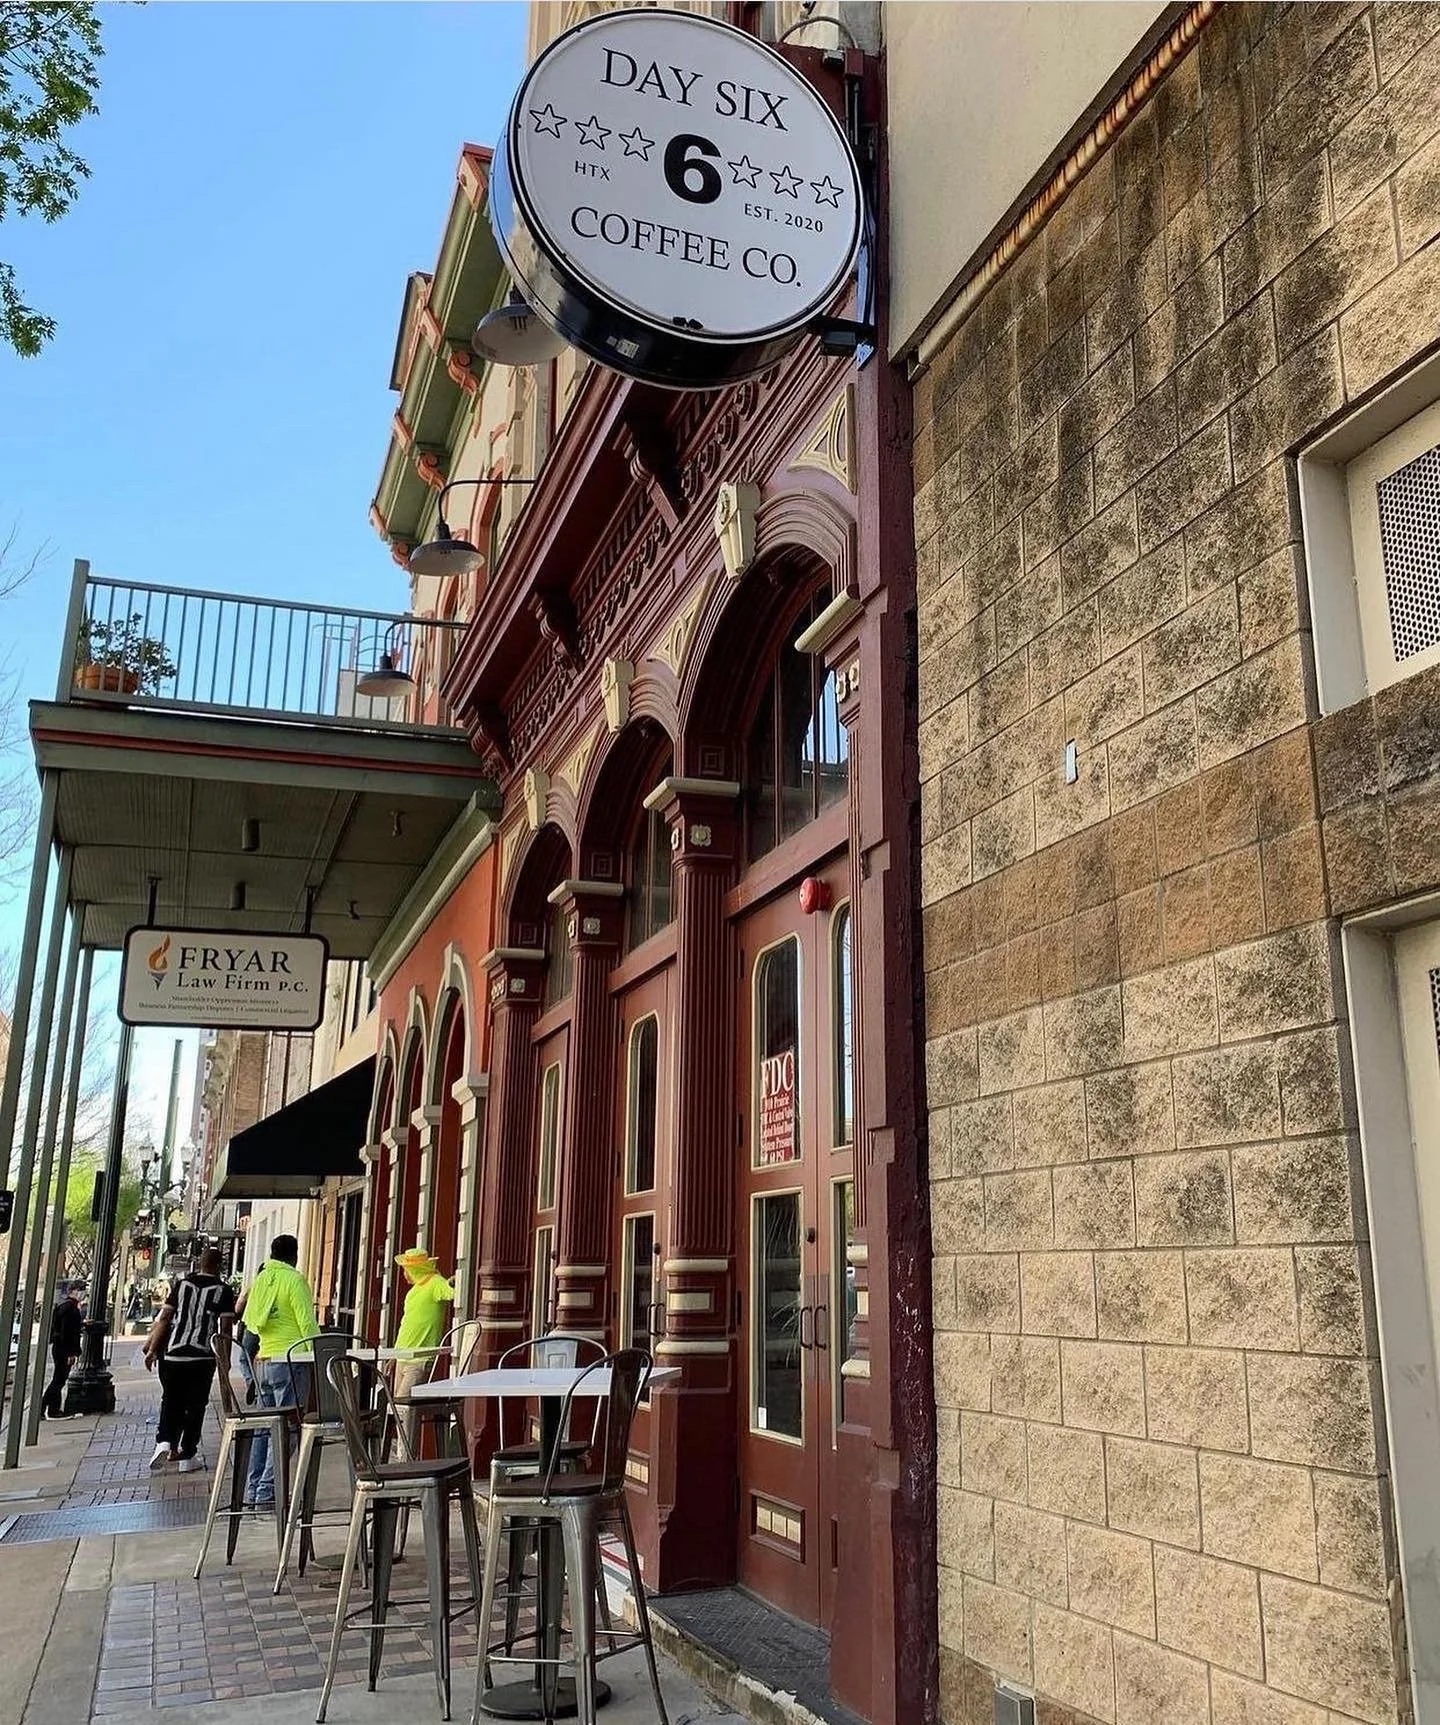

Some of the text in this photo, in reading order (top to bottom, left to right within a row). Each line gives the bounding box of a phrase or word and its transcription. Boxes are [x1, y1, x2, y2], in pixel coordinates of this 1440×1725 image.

[600, 47, 790, 132] DAY SIX
[574, 160, 611, 182] HTX
[663, 133, 723, 205] 6
[744, 203, 824, 233] EST. 2020
[570, 206, 803, 287] COFFEE CO.
[178, 946, 292, 974] FRYAR
[177, 972, 309, 993] Law Firm P.C.
[761, 1052, 795, 1097] FDC
